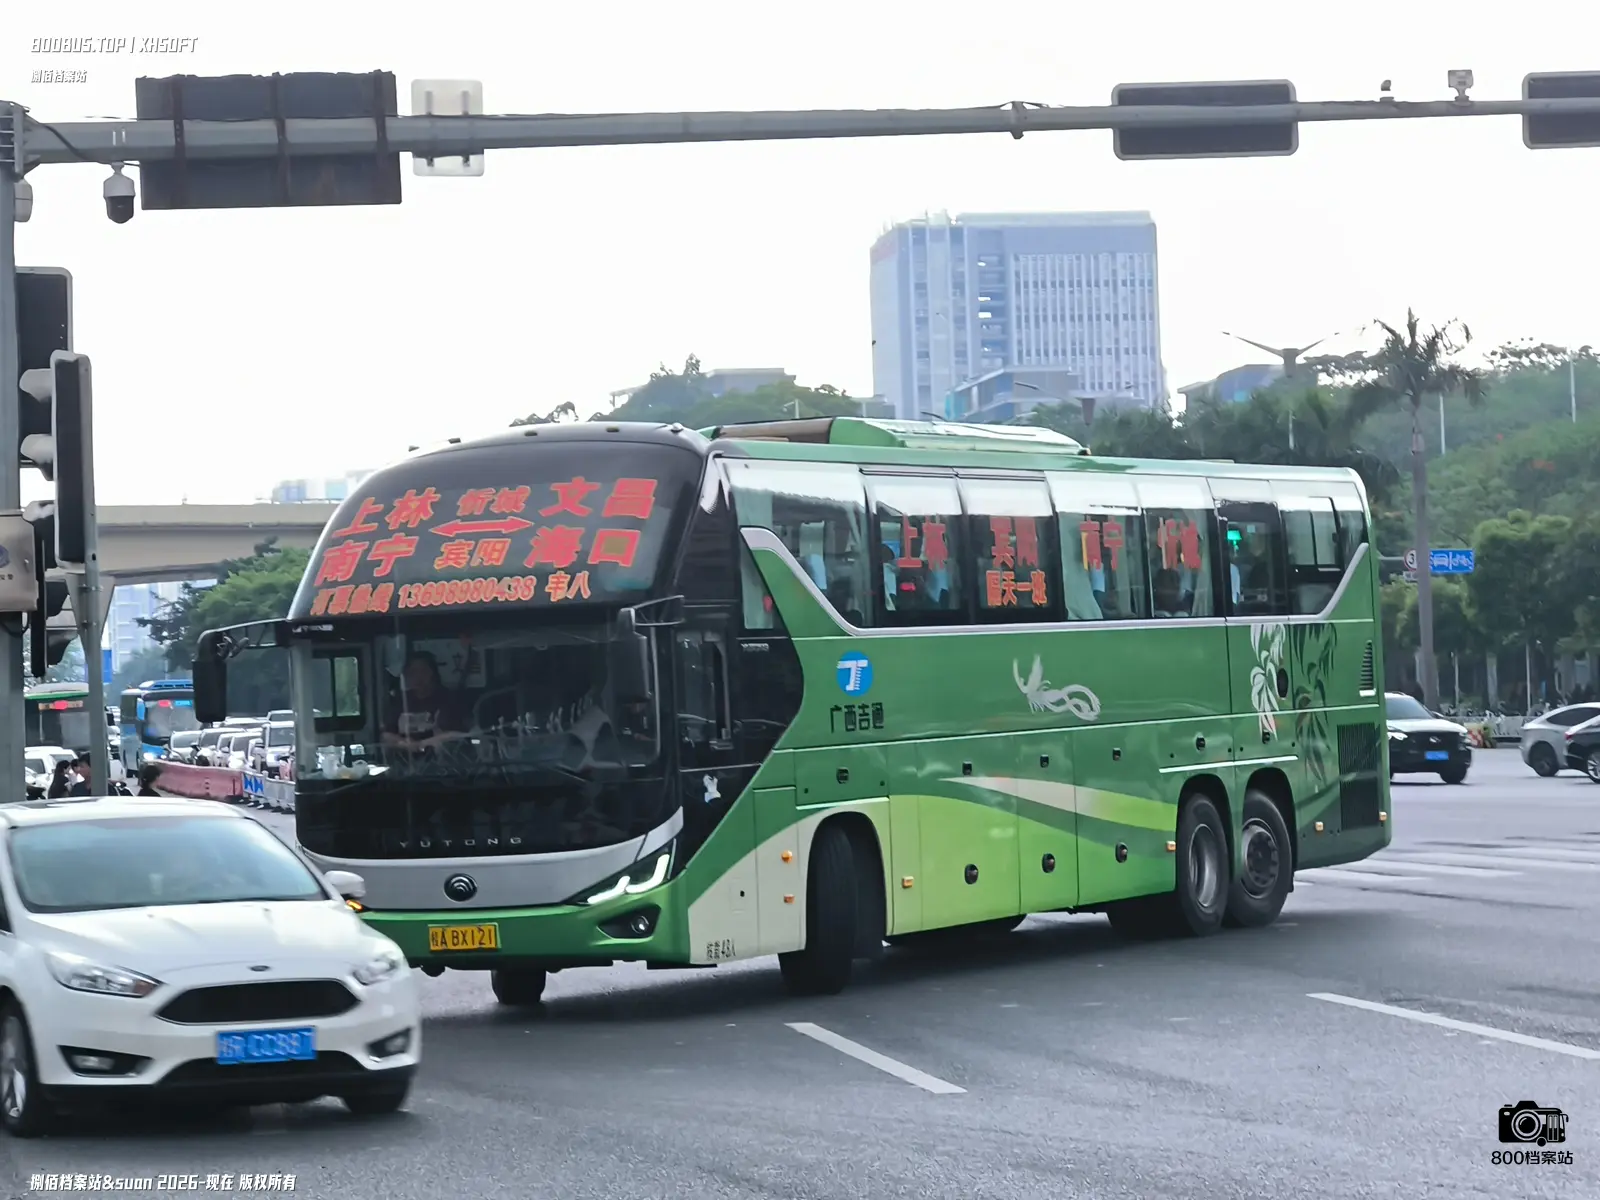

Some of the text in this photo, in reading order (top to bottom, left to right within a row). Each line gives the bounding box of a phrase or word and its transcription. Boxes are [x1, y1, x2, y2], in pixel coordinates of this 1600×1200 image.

[331, 487, 441, 538] 上林
[538, 476, 658, 519] 文昌
[313, 524, 641, 587] 南宁 宾阳 海口
[1078, 514, 1124, 571] 南宁
[830, 702, 884, 734] 广西吉通
[399, 836, 523, 849] YUTONG
